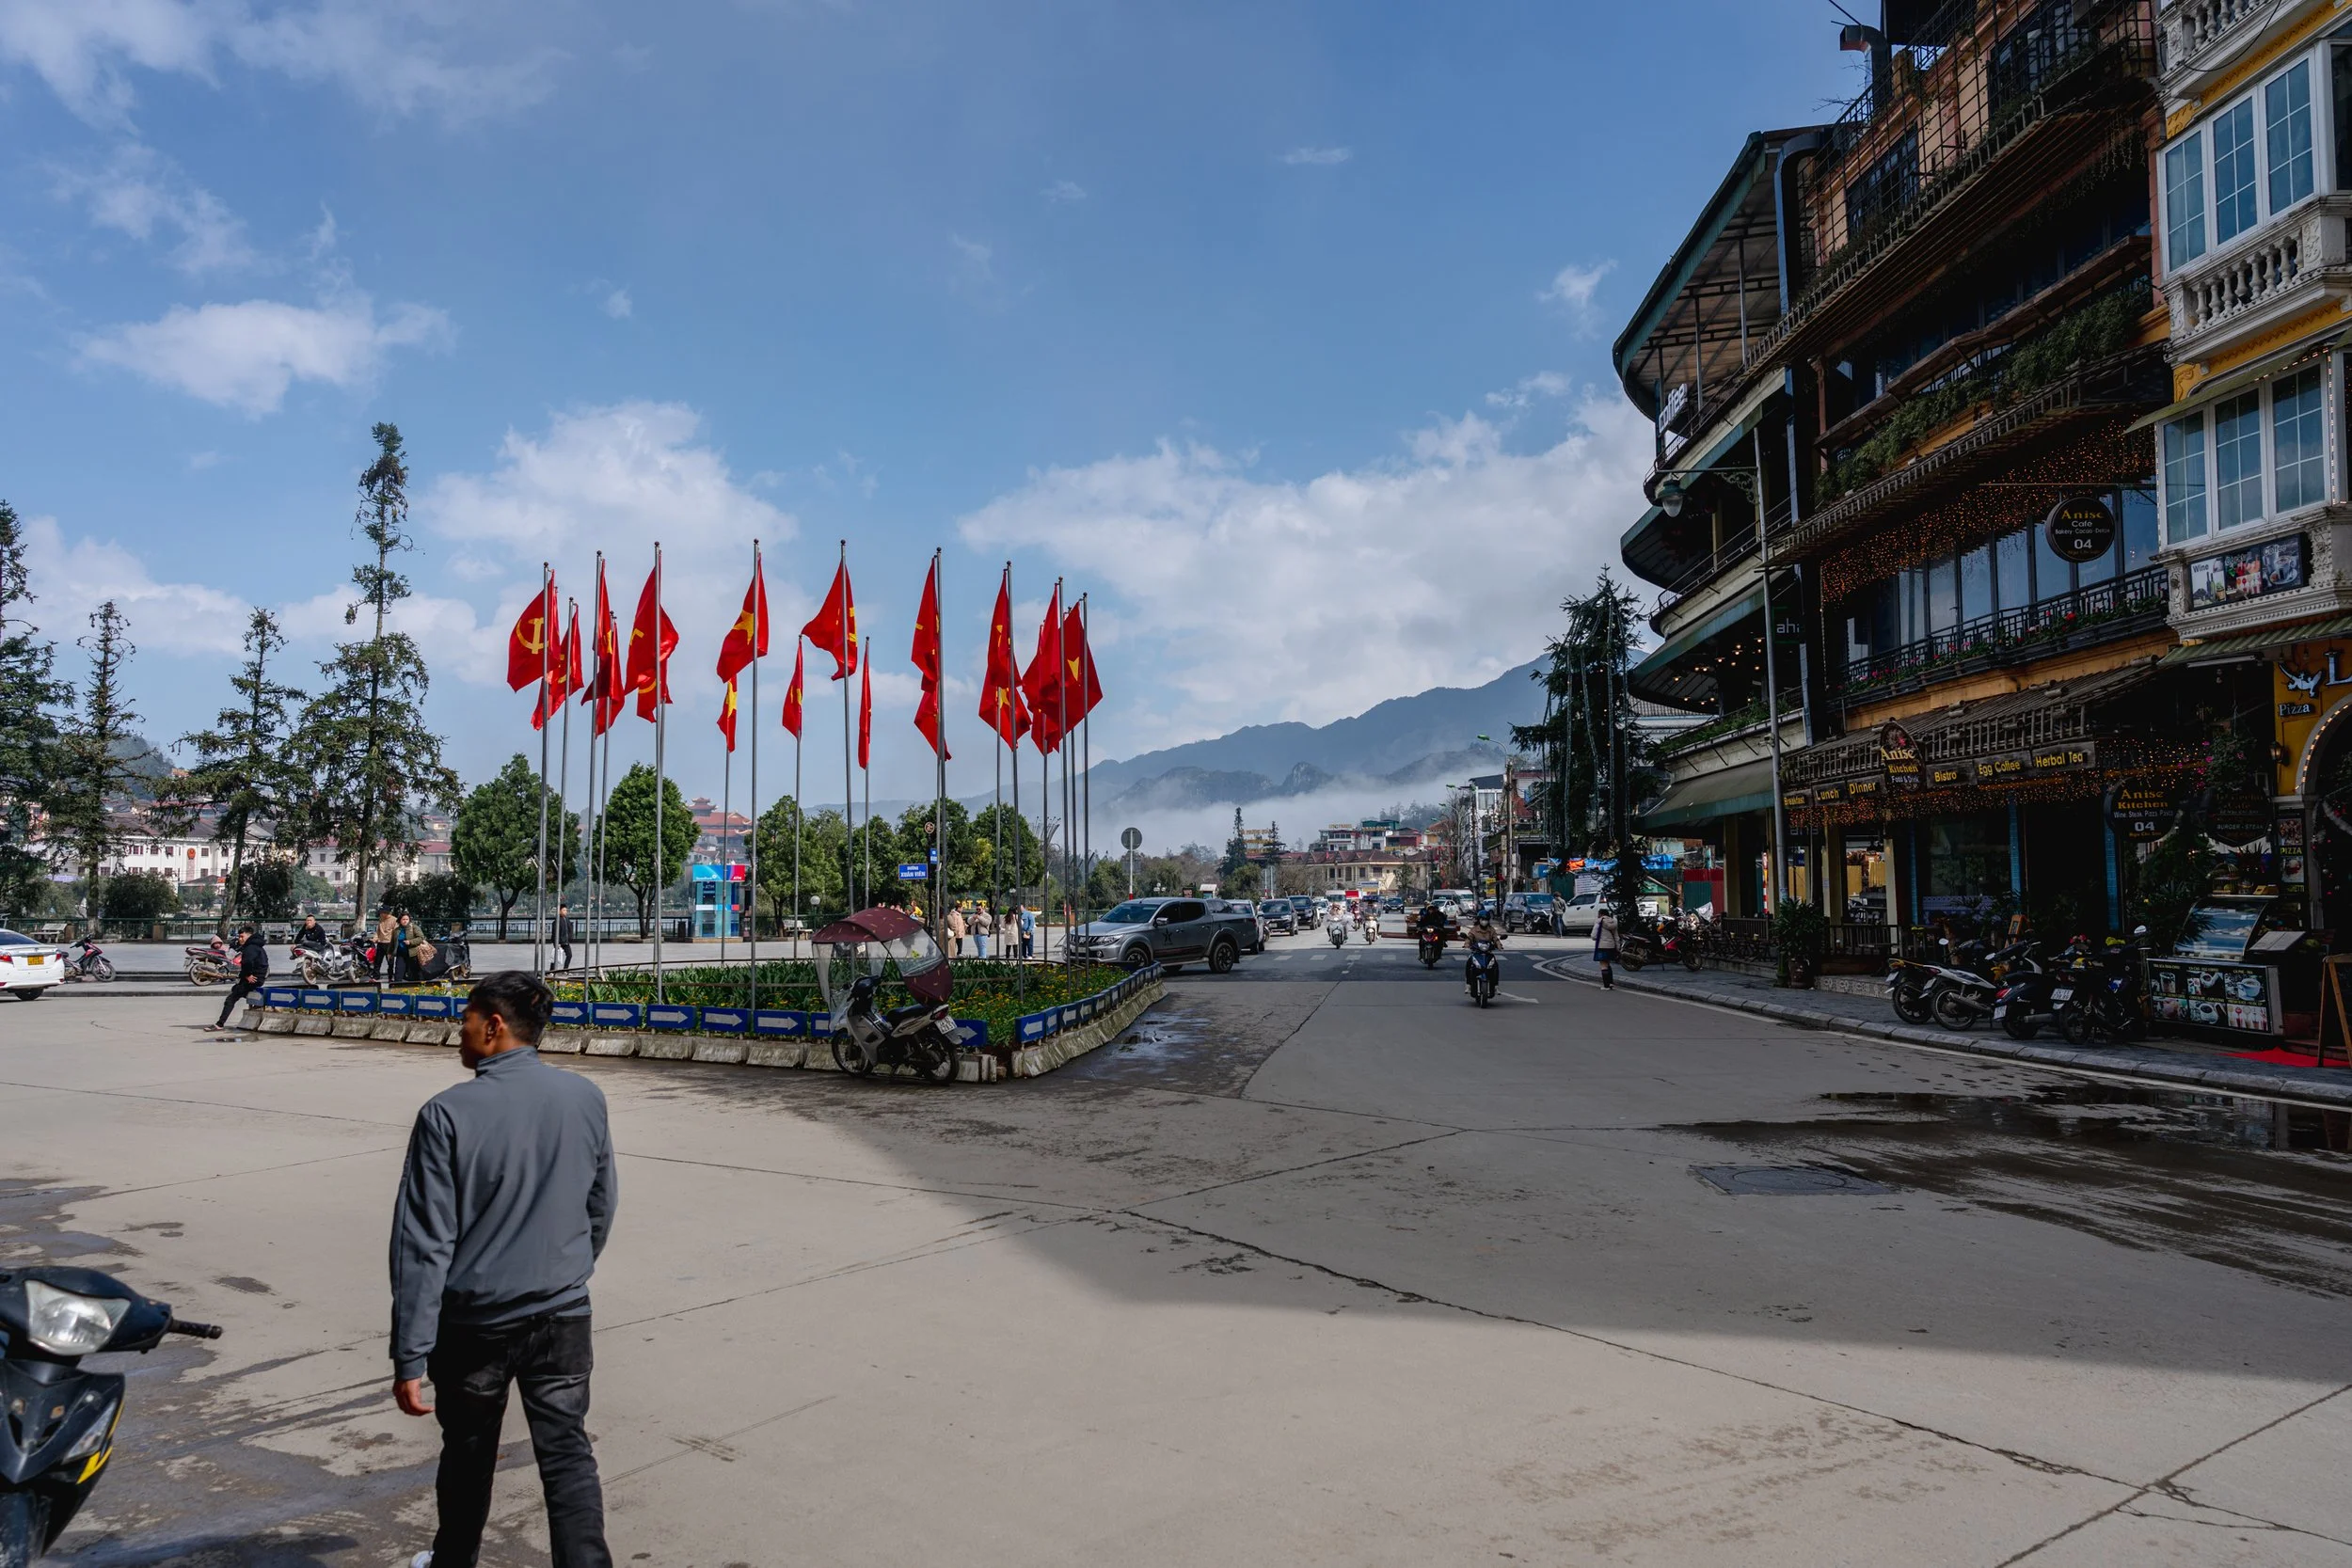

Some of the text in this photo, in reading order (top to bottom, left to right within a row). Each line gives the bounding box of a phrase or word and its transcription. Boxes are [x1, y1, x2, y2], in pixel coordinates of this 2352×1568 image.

[1659, 383, 1688, 433] coffee
[2061, 509, 2105, 519] Anise
[2074, 538, 2092, 549] 04
[2264, 545, 2287, 557] Coffee
[2192, 563, 2209, 573] Wine
[2279, 703, 2311, 717] Pizza
[1880, 745, 1915, 761] Anise
[2035, 752, 2084, 768] Herbal Tea
[1887, 764, 1919, 774] Kitchen
[1979, 760, 2021, 777] Egg Coffee
[1934, 769, 1958, 783] Bistro
[1815, 788, 1839, 800] Lunch
[1849, 782, 1877, 795] Dinner
[2121, 788, 2165, 800] Anise
[1783, 795, 1805, 806] Breakfast
[2117, 800, 2169, 810] Kitchen
[2134, 821, 2155, 832] 04
